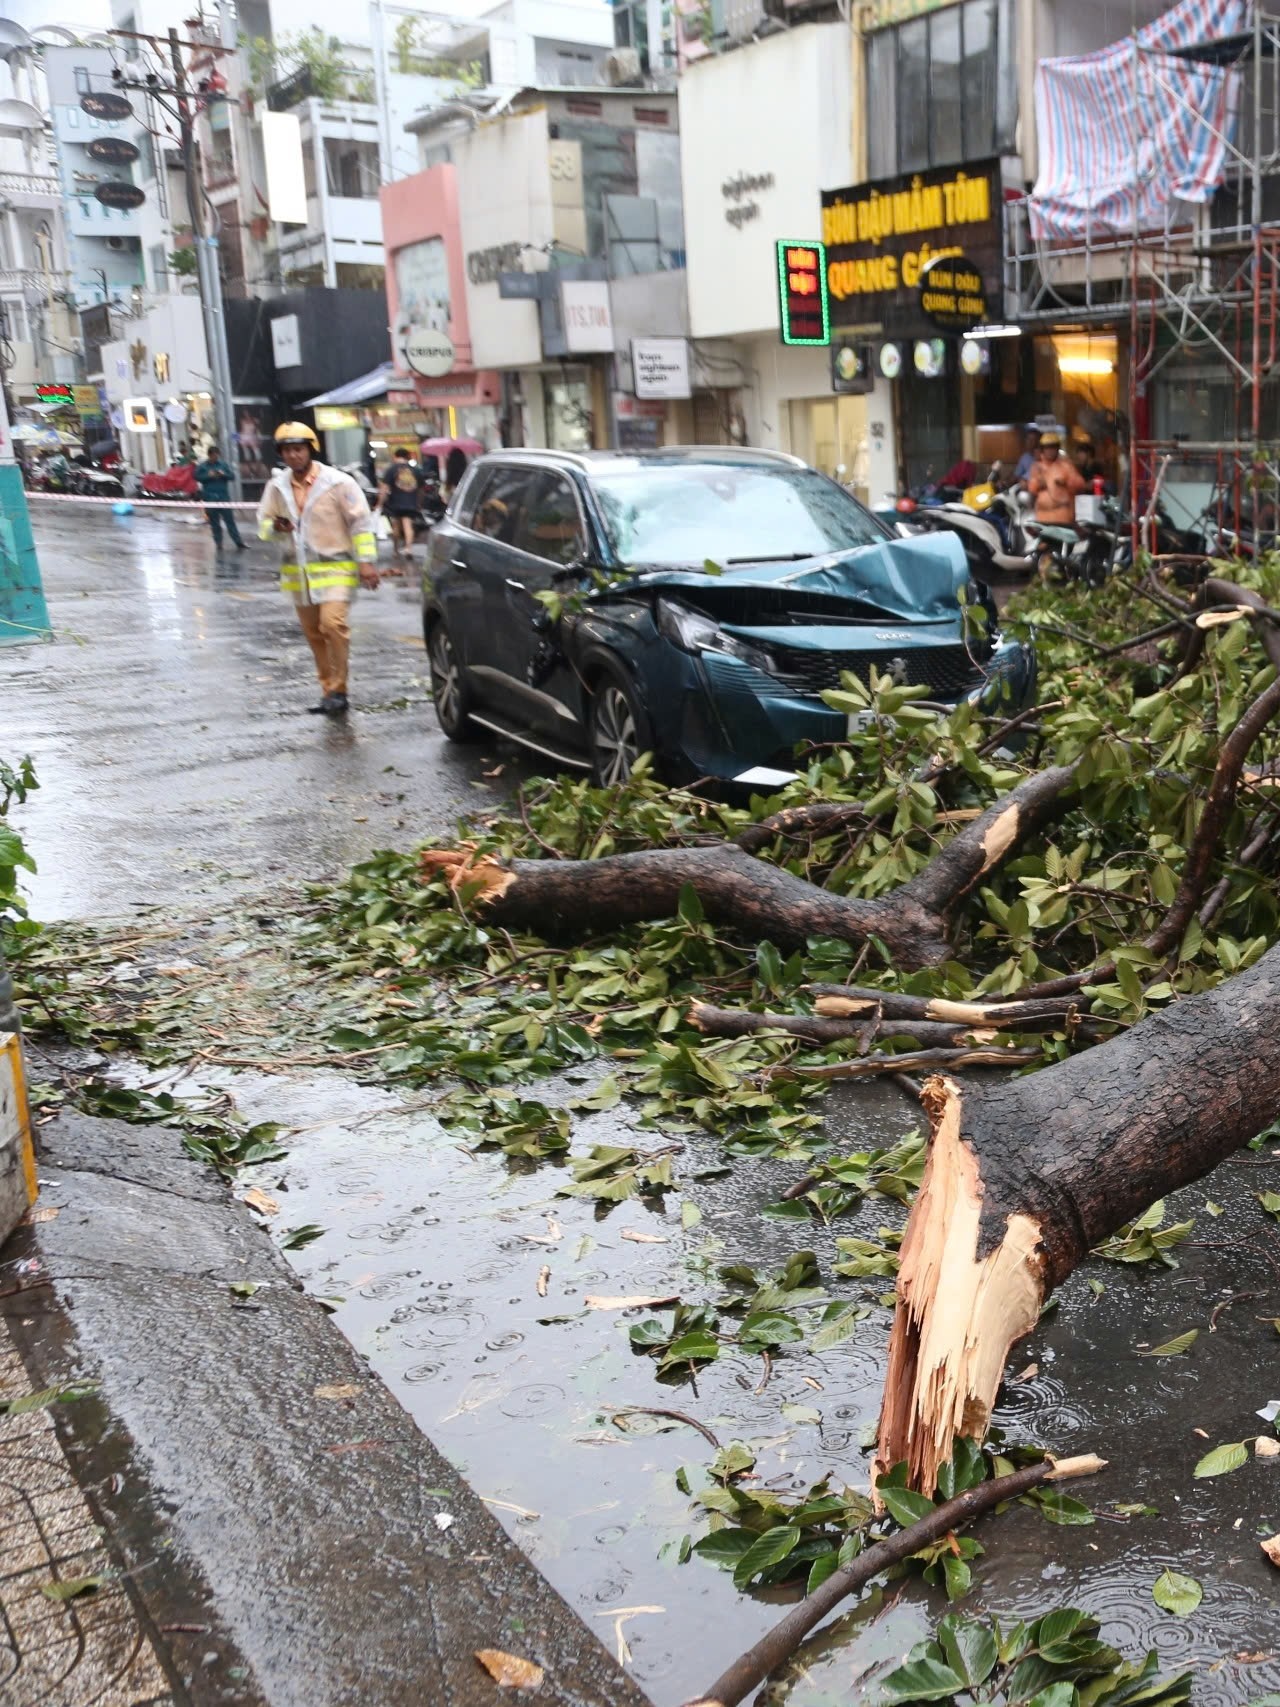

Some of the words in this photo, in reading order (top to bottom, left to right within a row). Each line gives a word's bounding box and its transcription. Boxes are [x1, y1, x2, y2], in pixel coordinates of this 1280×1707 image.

[822, 197, 857, 246] BÚN
[857, 189, 893, 245] ĐẬU
[893, 175, 943, 235] MẮM
[943, 171, 990, 226] TÔM
[828, 255, 897, 301] QUANG
